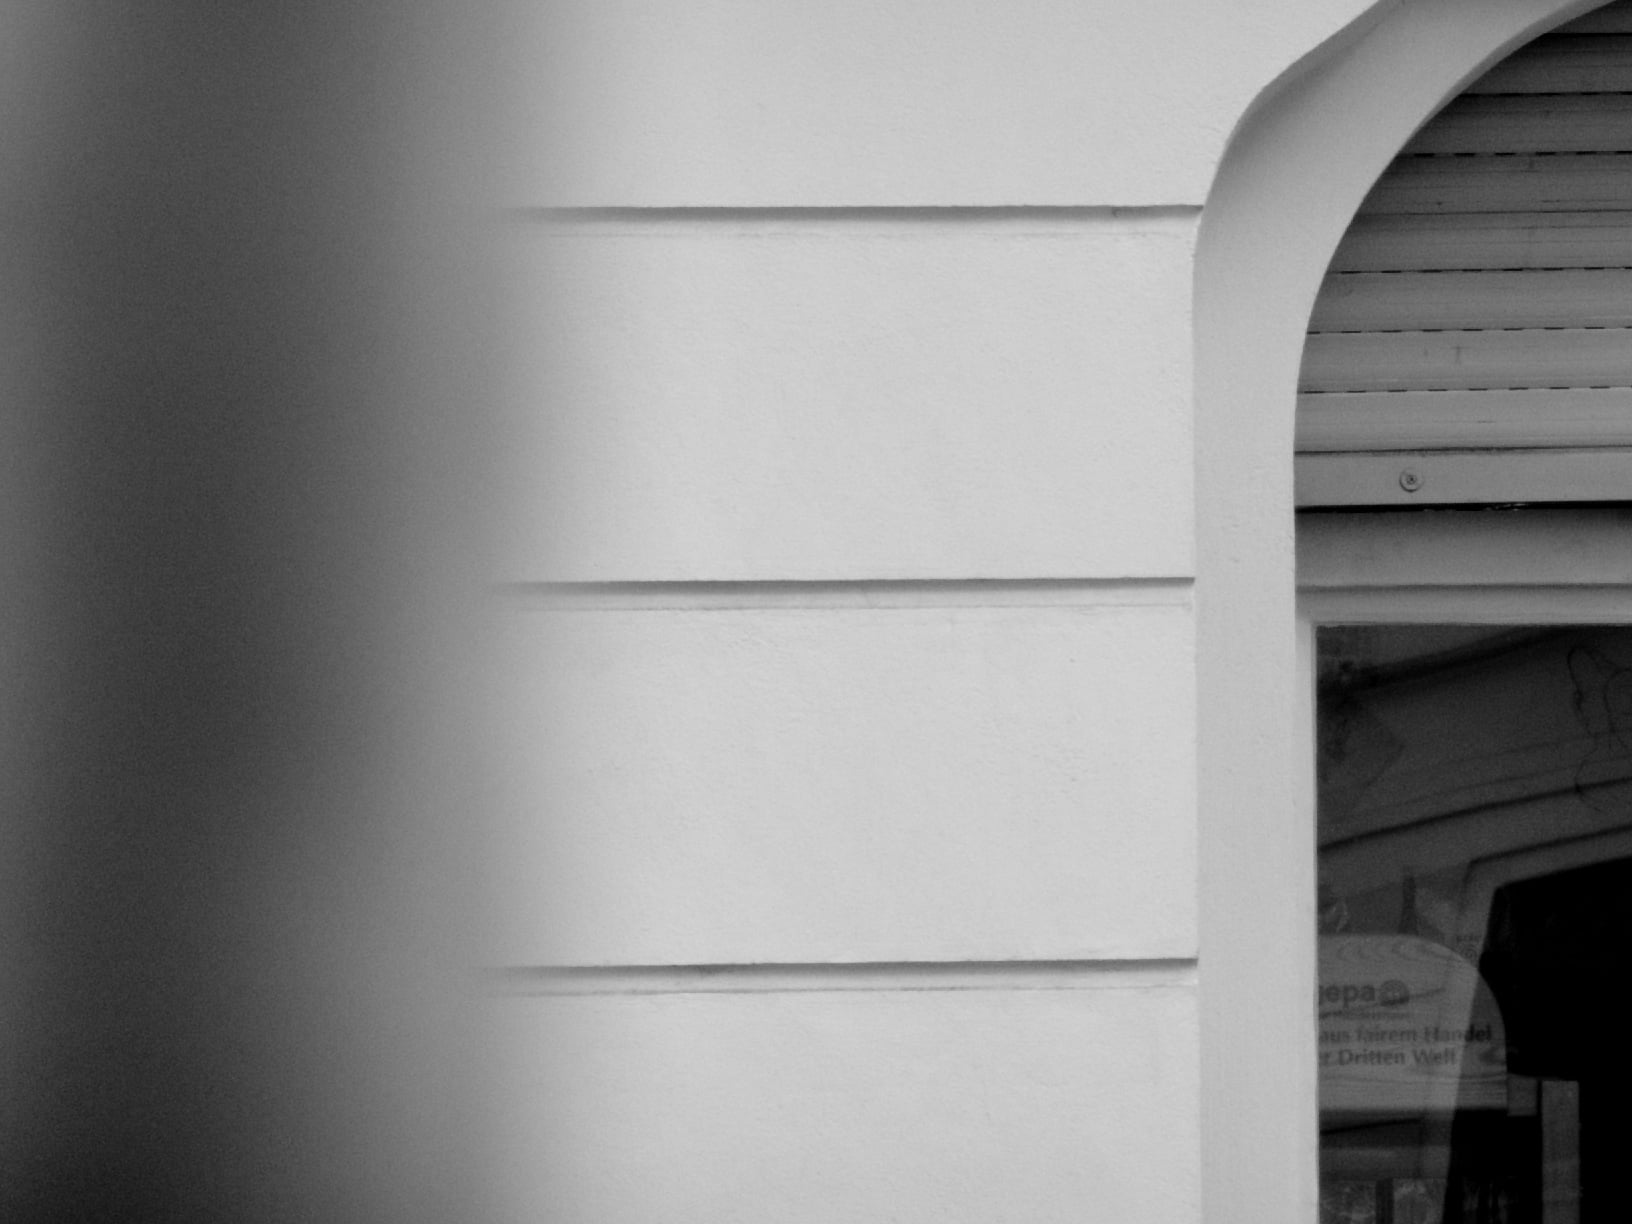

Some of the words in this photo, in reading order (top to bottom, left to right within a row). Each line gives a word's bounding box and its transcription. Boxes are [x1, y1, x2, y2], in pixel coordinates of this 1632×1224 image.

[1424, 1024, 1493, 1042] Handel
[1338, 1048, 1405, 1065] Dritten
[1412, 1048, 1457, 1065] Welt
